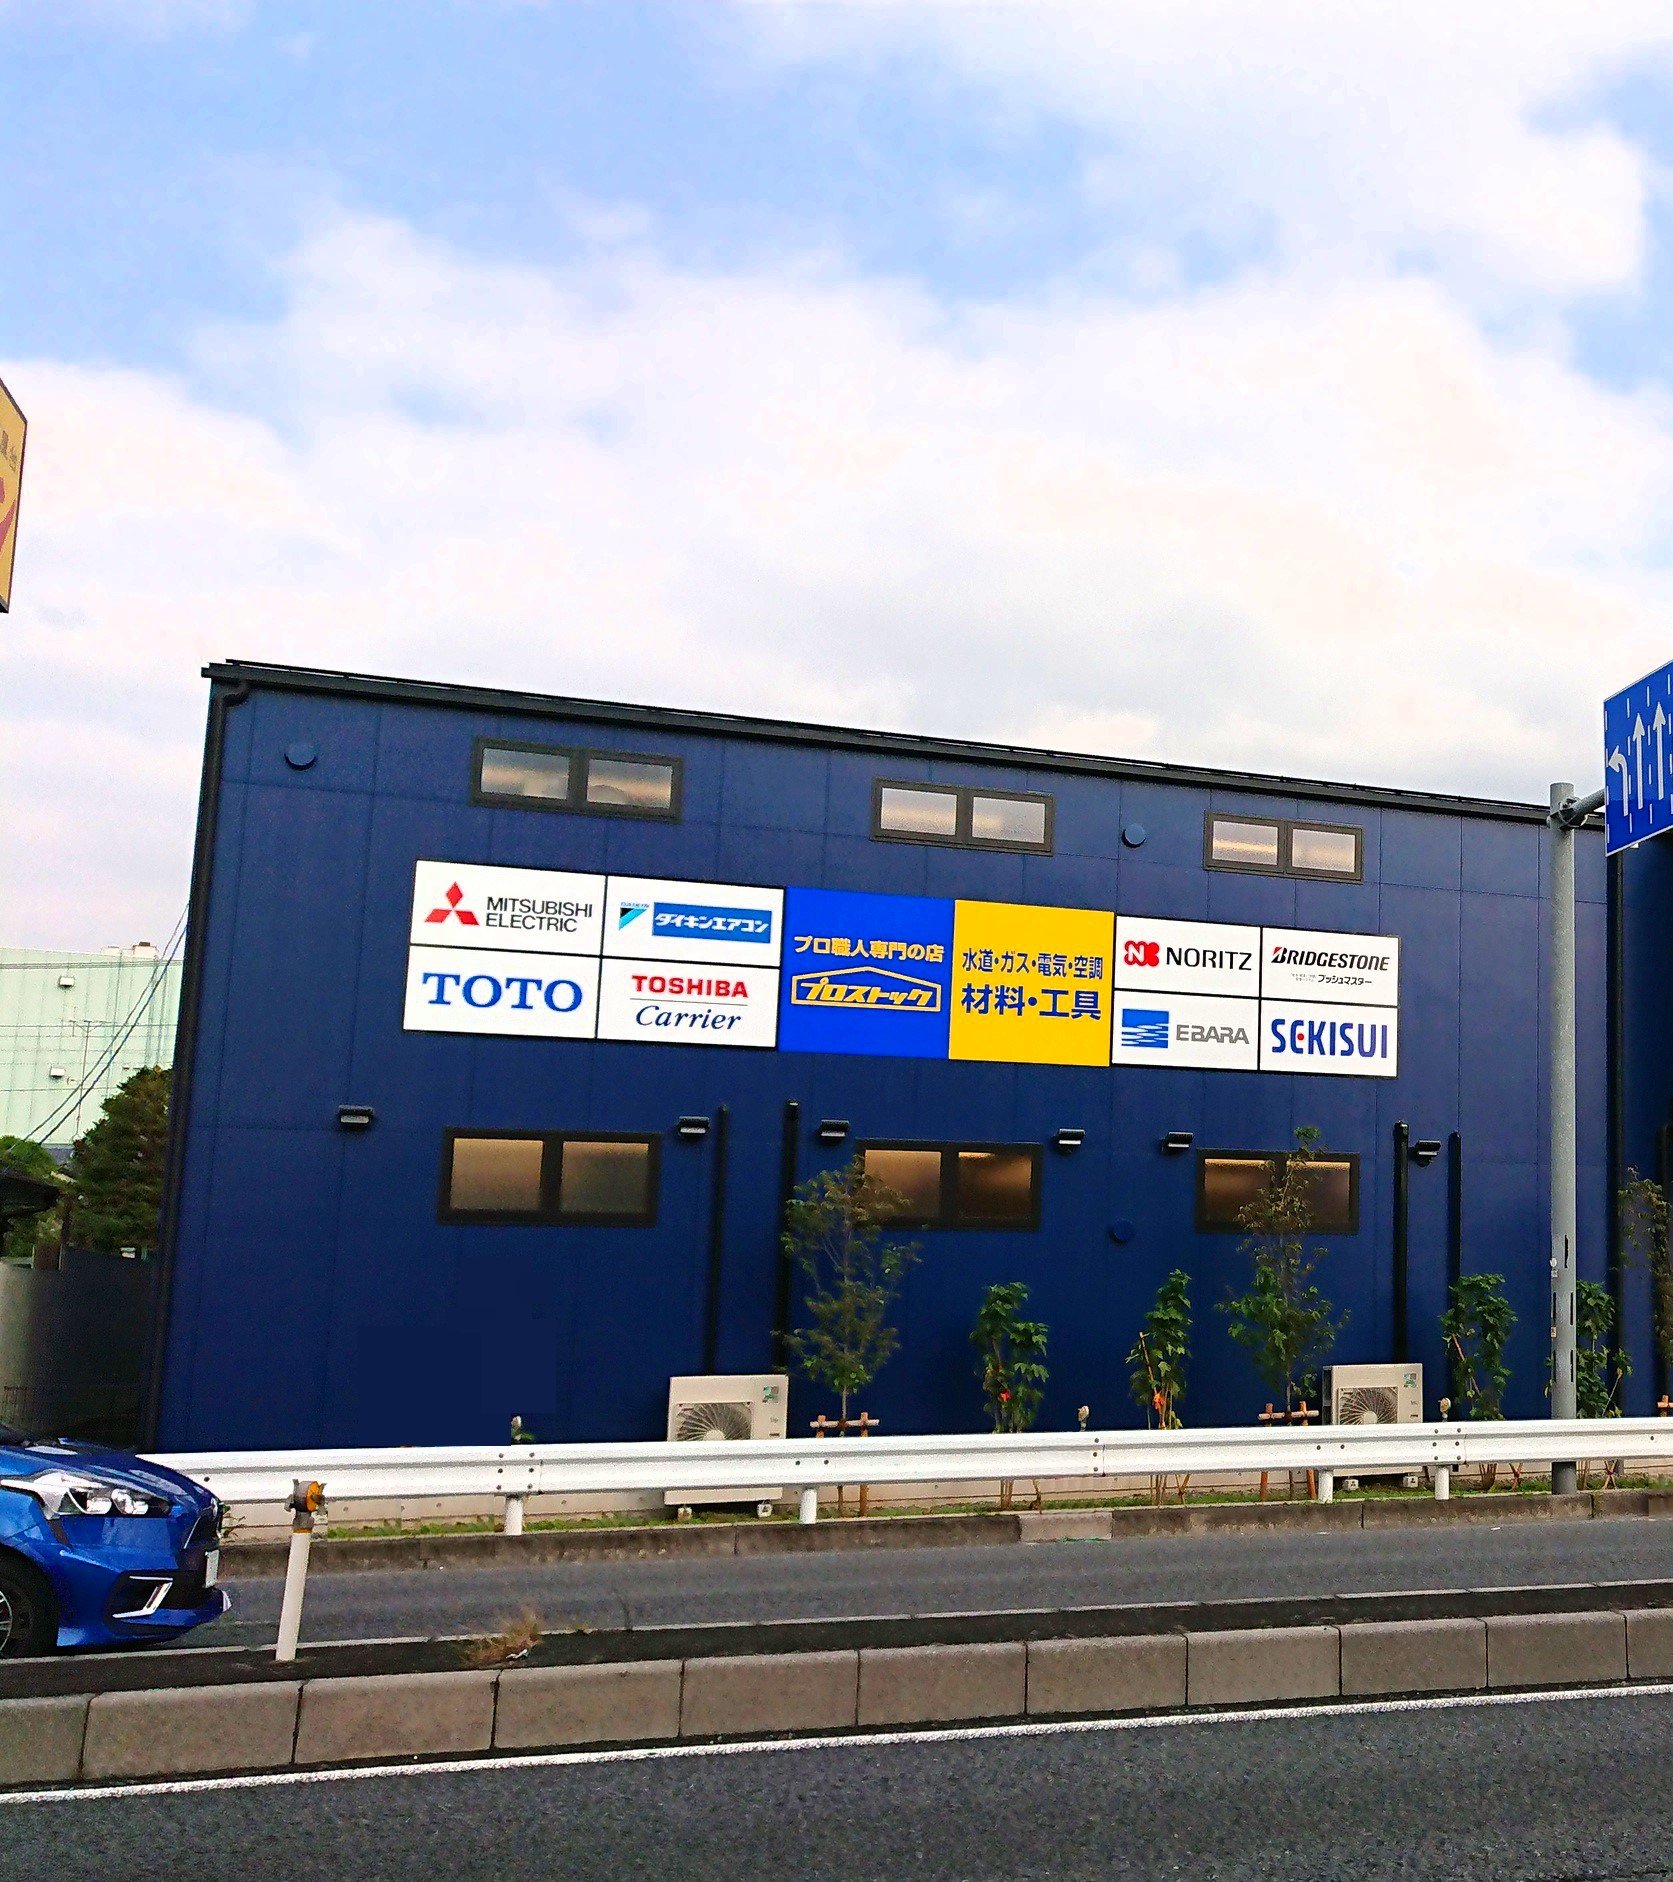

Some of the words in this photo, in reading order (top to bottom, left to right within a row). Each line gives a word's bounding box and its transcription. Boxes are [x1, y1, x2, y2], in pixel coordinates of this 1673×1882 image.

[486, 896, 593, 918] MITSUBISHI
[485, 912, 578, 933] ELECTRIC
[655, 913, 770, 934] ダイキンエアコン
[794, 935, 945, 963] プロ職人専門の店
[1166, 946, 1252, 971] NORITZ
[1271, 946, 1390, 971] BRIDGESTONE
[422, 971, 583, 1013] TOTO
[632, 974, 749, 999] TOSHIBA
[801, 980, 935, 1006] プロストック
[961, 982, 1102, 1021] 材料・工具
[635, 1005, 742, 1032] Carrier
[1175, 1024, 1250, 1045] EBARA
[1271, 1018, 1388, 1059] SEKISUI
